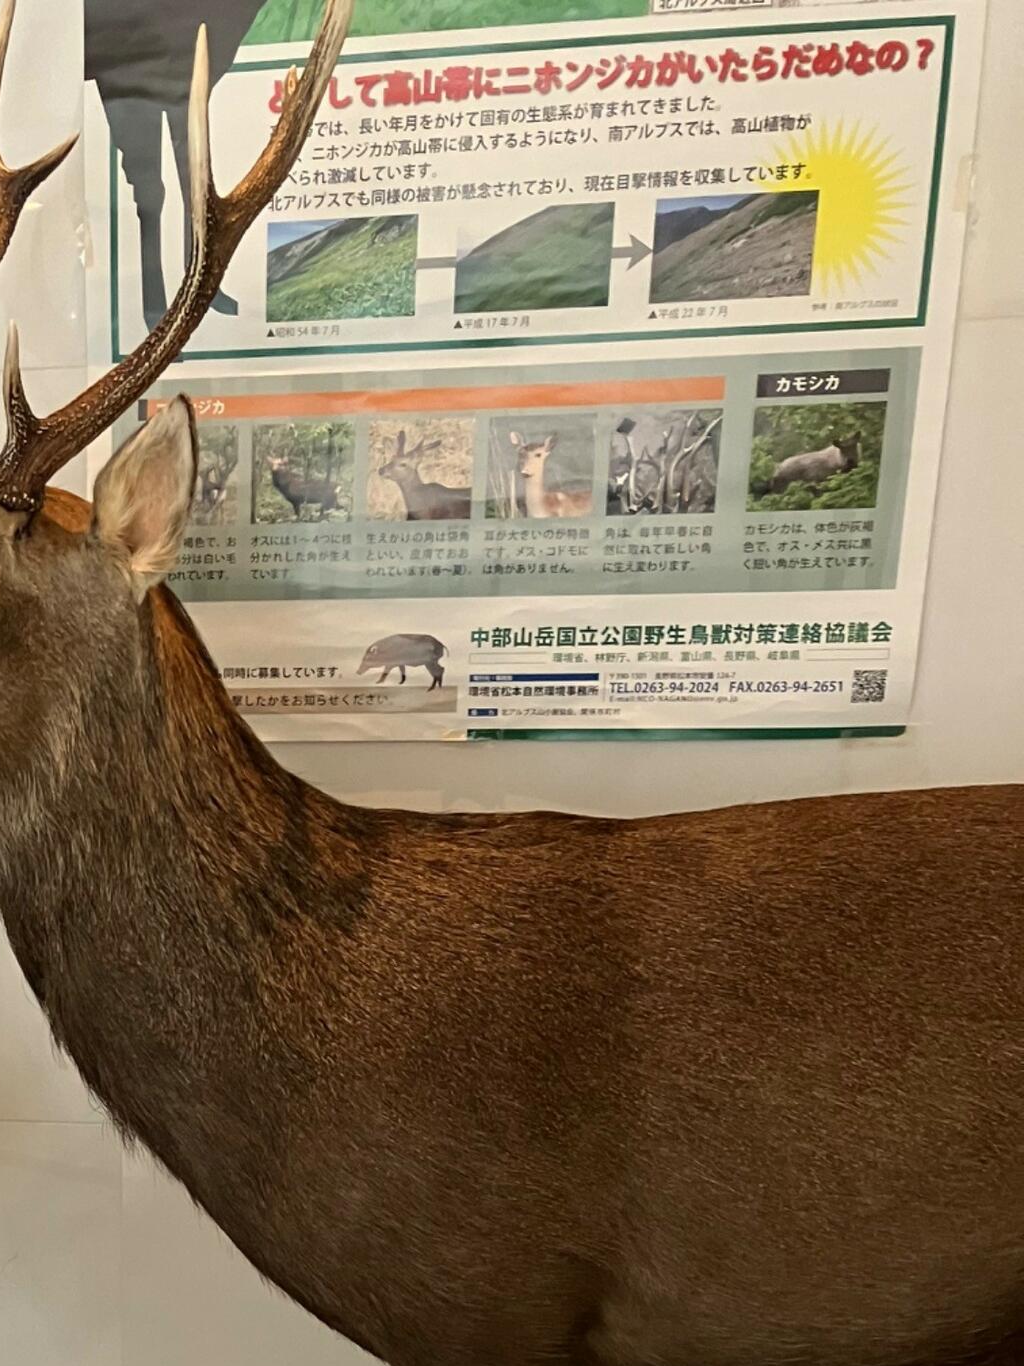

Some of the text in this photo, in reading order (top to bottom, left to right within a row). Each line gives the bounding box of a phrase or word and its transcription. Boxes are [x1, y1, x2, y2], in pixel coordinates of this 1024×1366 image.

[268, 38, 935, 114] どして高山帯にニホンジカがいたらだめなの？
[271, 95, 721, 138] では、長い年月をかけて固有の生態系が育まれてきました。
[286, 163, 438, 186] べられ激減しています。
[269, 163, 812, 212] 北アルプスでも同様の被害が懸念されており、現在目撃情報を収集しています。
[776, 374, 840, 393] カモシカ
[482, 563, 575, 575] は角がありません。
[602, 560, 695, 573] に生え変わります。
[743, 555, 874, 570] く短い角が生えています。
[470, 621, 894, 648] 中部山岳国立公園野生鳥獣対策連絡協議会
[468, 686, 600, 697] 環境省松本自然環境事務所
[609, 680, 843, 694] TEL.0263-94-2024 FAX.0263-94-2651
